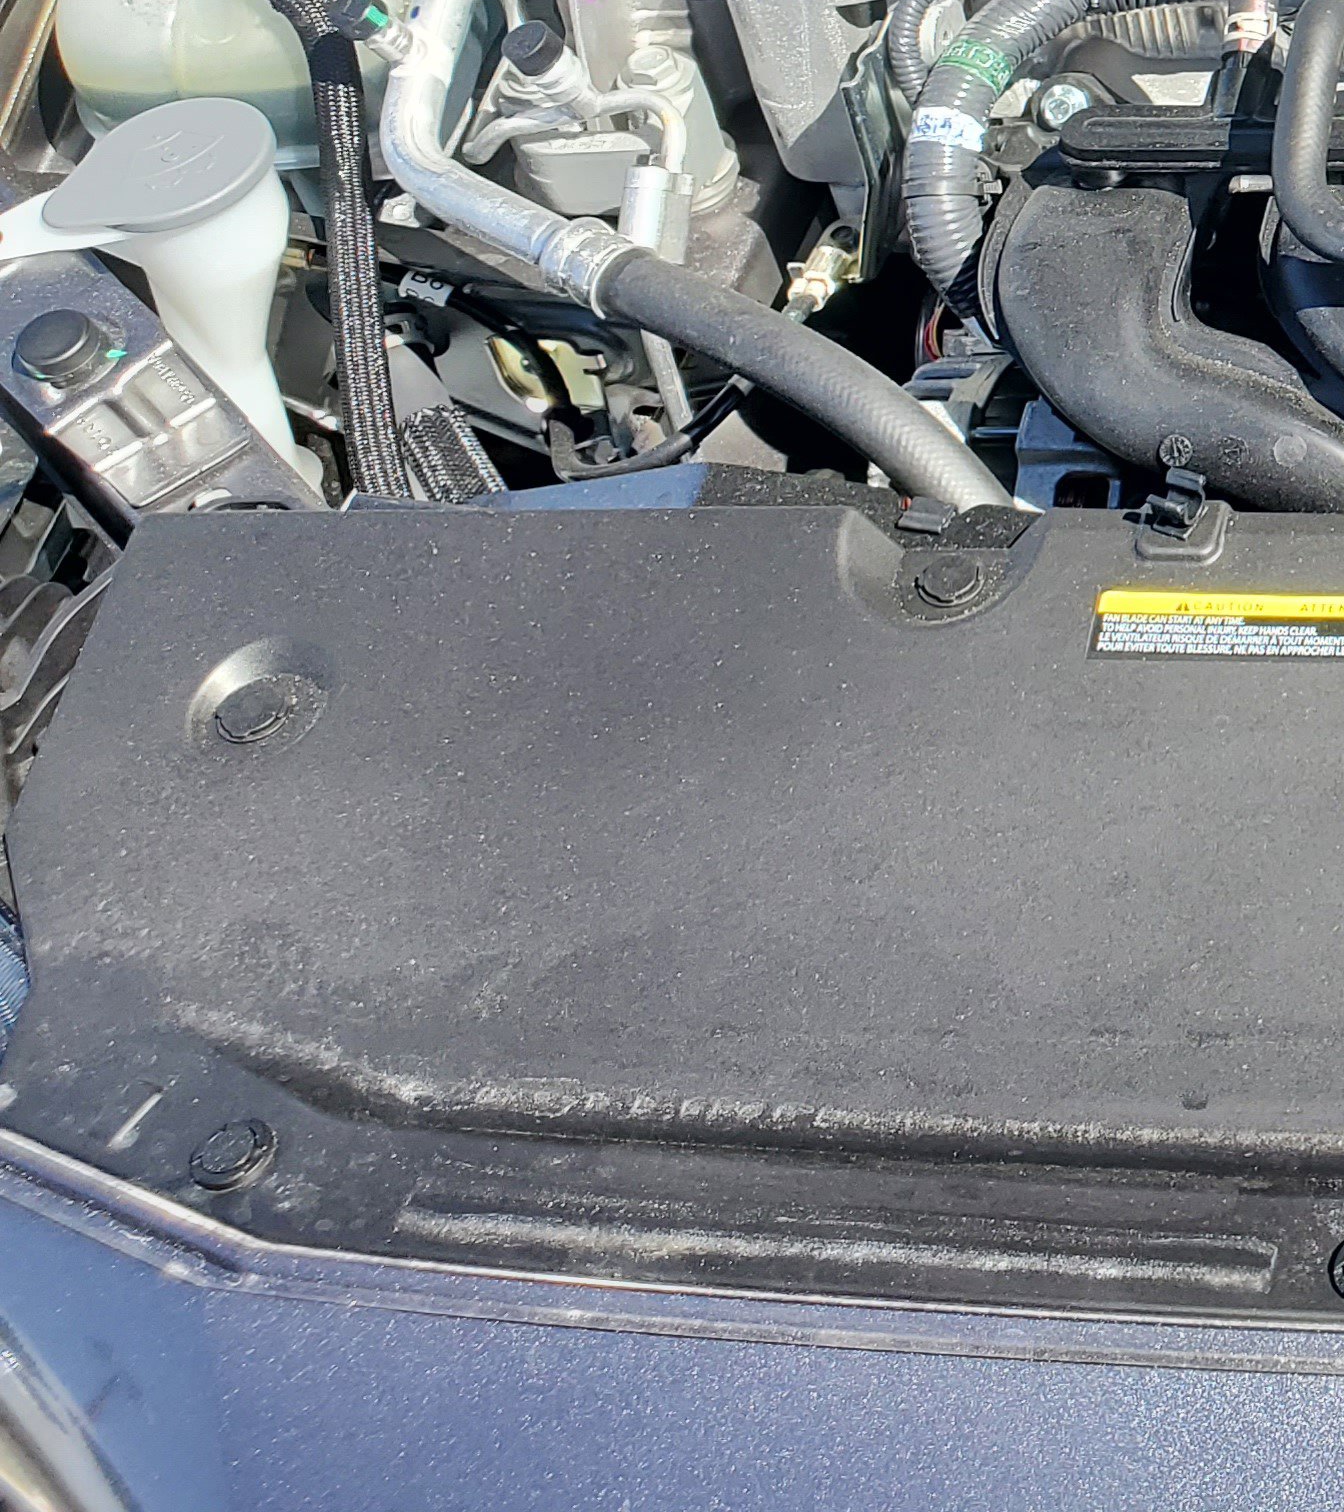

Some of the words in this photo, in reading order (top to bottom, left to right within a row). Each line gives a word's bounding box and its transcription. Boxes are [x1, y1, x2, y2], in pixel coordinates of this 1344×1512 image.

[1194, 601, 1263, 611] CAUTION
[1103, 614, 1120, 622] FAN
[1121, 615, 1148, 623] BLADE
[1149, 616, 1167, 624] CAN
[1168, 616, 1193, 624] START
[1194, 617, 1205, 625] AT
[1206, 617, 1222, 625] ANY
[1102, 623, 1113, 632] TO
[1115, 623, 1136, 632] HELP
[1137, 624, 1163, 633] AVOID
[1164, 625, 1206, 634] PERSONAL
[1239, 627, 1259, 635] KEEP
[1259, 626, 1288, 635] HANDS
[1290, 627, 1318, 636] CLEAR.
[1099, 632, 1110, 641] LE
[1112, 632, 1170, 642] VENTILATEUR
[1172, 634, 1205, 643] RISQUE
[1206, 635, 1219, 644] DE
[1278, 636, 1302, 646] TOUT
[1096, 642, 1123, 651] POUR
[1156, 643, 1185, 653] TOUTE
[1233, 645, 1247, 654] NE
[1248, 646, 1265, 655] PAS
[1266, 646, 1280, 655] EN
[1278, 646, 1335, 656] APPROCHER
